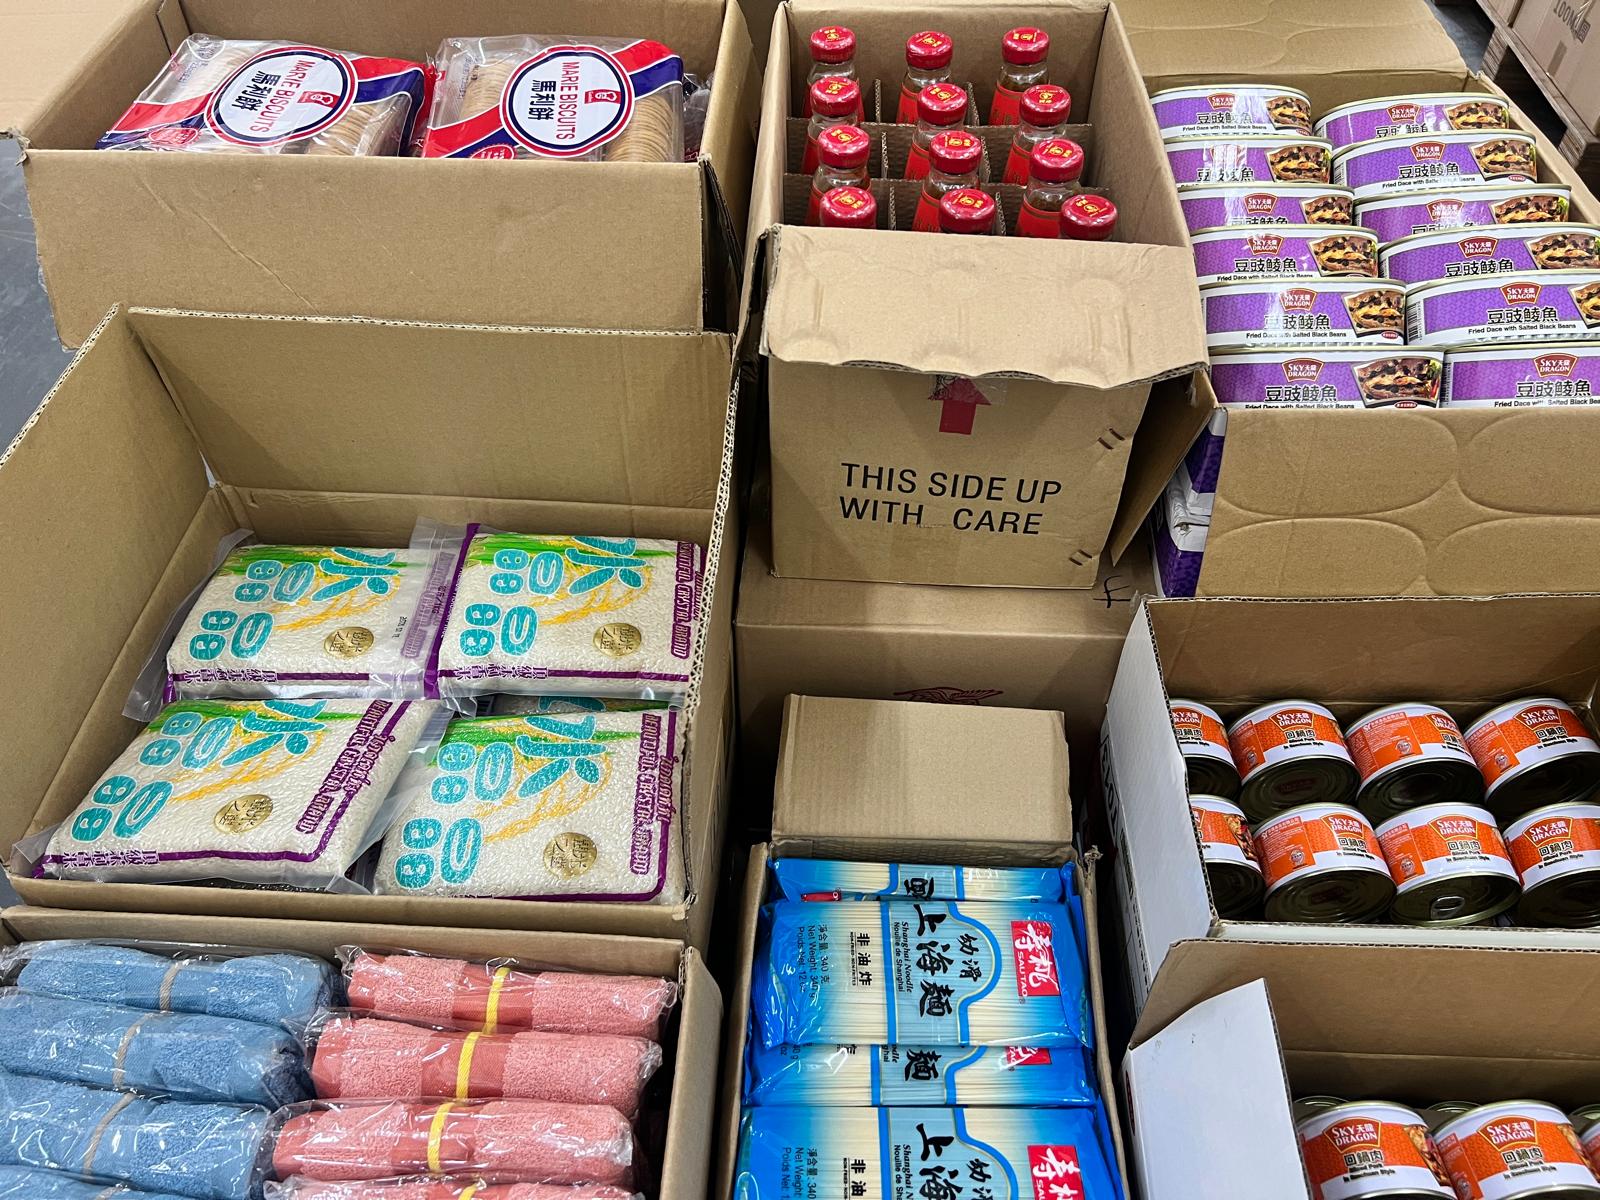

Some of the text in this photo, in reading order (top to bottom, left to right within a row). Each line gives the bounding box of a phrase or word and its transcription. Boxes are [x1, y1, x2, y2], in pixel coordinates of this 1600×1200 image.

[232, 71, 281, 111] 馬利餅
[250, 60, 315, 132] MARIE BISCUITS
[528, 80, 557, 120] 馬利餅
[556, 61, 580, 140] MARIE BISCUITS
[1399, 163, 1460, 178] 豆豉鯪魚
[1234, 258, 1297, 272] 豆豉鯪魚
[1445, 258, 1514, 277] 豆豉鯪魚
[1487, 307, 1559, 324] 豆豉鯪魚
[1265, 385, 1337, 402] 豆豉鯪魚
[1516, 380, 1591, 397] 豆豉鯪魚
[840, 463, 1062, 504] THIS SIDE UP
[839, 495, 1043, 535] WITH CARE
[676, 585, 692, 622] CRYSTAL
[672, 625, 689, 658] BRAND
[348, 700, 392, 746] BEAUTIFUL
[1521, 711, 1540, 720] SKY
[1525, 715, 1559, 725] DRAGON
[320, 748, 360, 792] CRYSTAL
[298, 794, 334, 832] BRAND
[1328, 817, 1347, 827] SKY
[1332, 824, 1362, 834] DRAGON
[1436, 820, 1458, 830] SKY
[1529, 825, 1550, 836] SKY
[1439, 827, 1476, 835] DRAGON
[1531, 827, 1569, 842] DRAGON
[1448, 841, 1480, 850] 回鍋肉
[1539, 841, 1573, 855] 回鍋肉
[808, 925, 817, 940] Net
[857, 932, 872, 986] 非油炸
[894, 922, 905, 993] Nouille de Shanghai
[901, 921, 914, 993] Shanghai Noodle
[957, 933, 982, 982] 幼滑
[1017, 951, 1028, 997] SAU TAO
[1333, 1126, 1356, 1136] SKY
[1335, 1131, 1378, 1146] DRAGON
[1486, 1124, 1510, 1136] SKY
[1491, 1130, 1534, 1144] DRAGON
[782, 1147, 791, 1172] Poids
[795, 1147, 804, 1163] Net
[1344, 1150, 1383, 1166] 回鍋肉
[1502, 1149, 1542, 1164] 回鍋肉
[894, 1144, 903, 1184] Nouille de
[902, 1144, 913, 1189] Shanghai
[807, 1182, 817, 1200] 340
